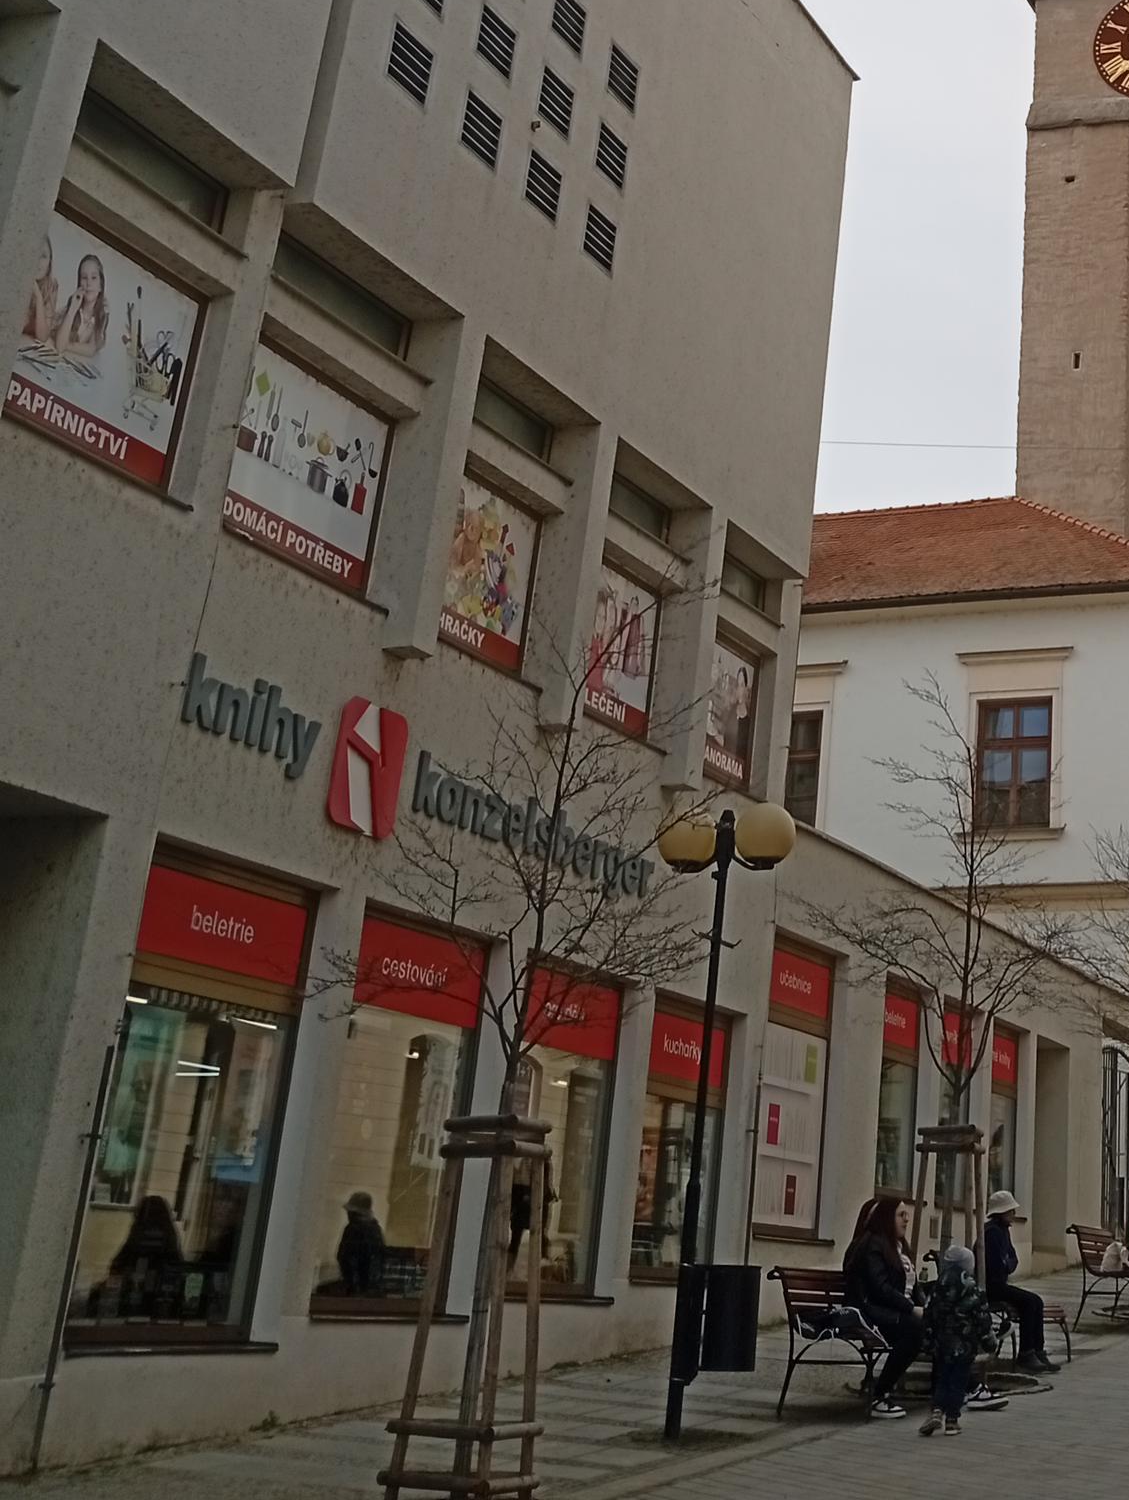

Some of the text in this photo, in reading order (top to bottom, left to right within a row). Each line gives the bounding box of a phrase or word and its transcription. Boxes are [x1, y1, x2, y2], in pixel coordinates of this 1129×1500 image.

[1107, 20, 1127, 34] X
[7, 379, 129, 460] PAPÍRNICTVÍ
[223, 496, 353, 578] DOMÁCÍ POTŘEBY
[181, 652, 322, 779] knihy
[411, 750, 655, 900] kanzelsberger
[190, 905, 255, 944] beletrie
[381, 956, 448, 987] cestování
[780, 970, 812, 994] učebnice
[663, 1033, 702, 1065] kuchařky
